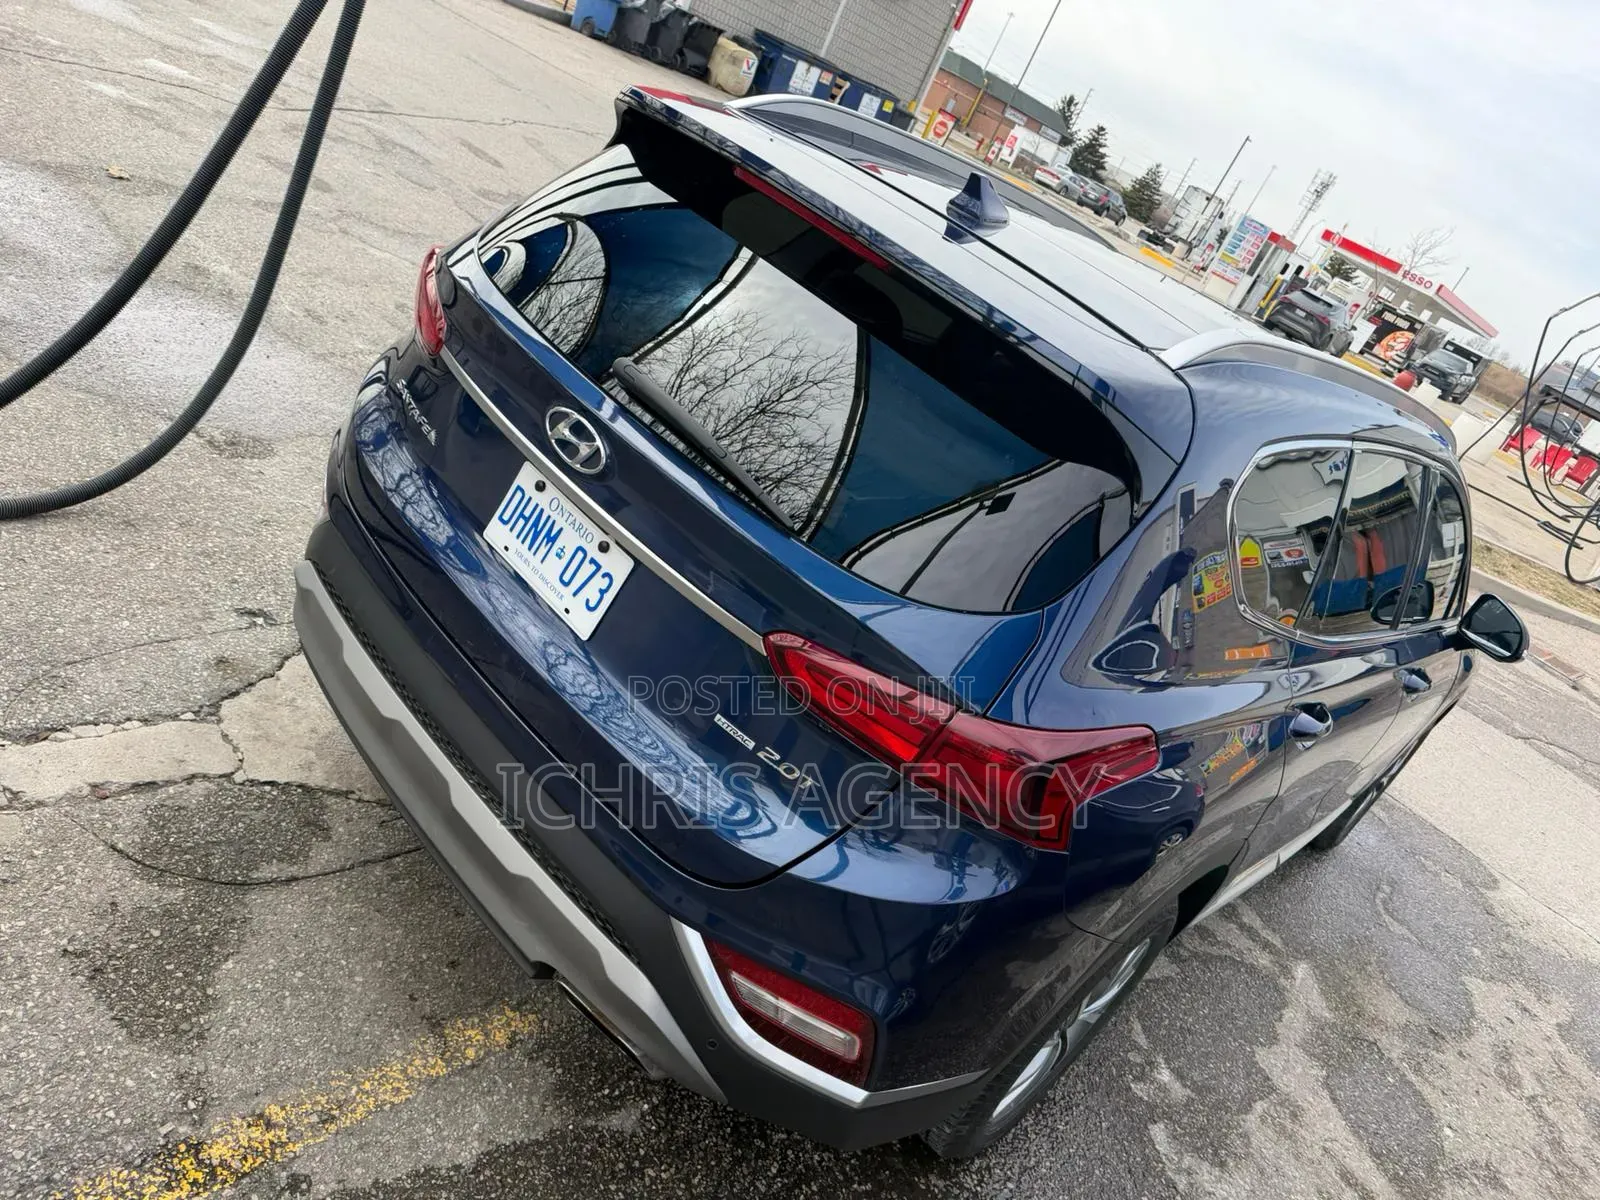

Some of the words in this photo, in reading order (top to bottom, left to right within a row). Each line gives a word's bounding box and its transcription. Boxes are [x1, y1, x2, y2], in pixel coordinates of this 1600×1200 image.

[549, 496, 595, 544] ONTARIO
[498, 485, 564, 564] DHNM
[559, 545, 614, 613] 073
[515, 548, 531, 567] YOURS
[531, 565, 540, 575] TO
[538, 572, 565, 600] DISCOVER
[715, 715, 754, 749] HTRAC
